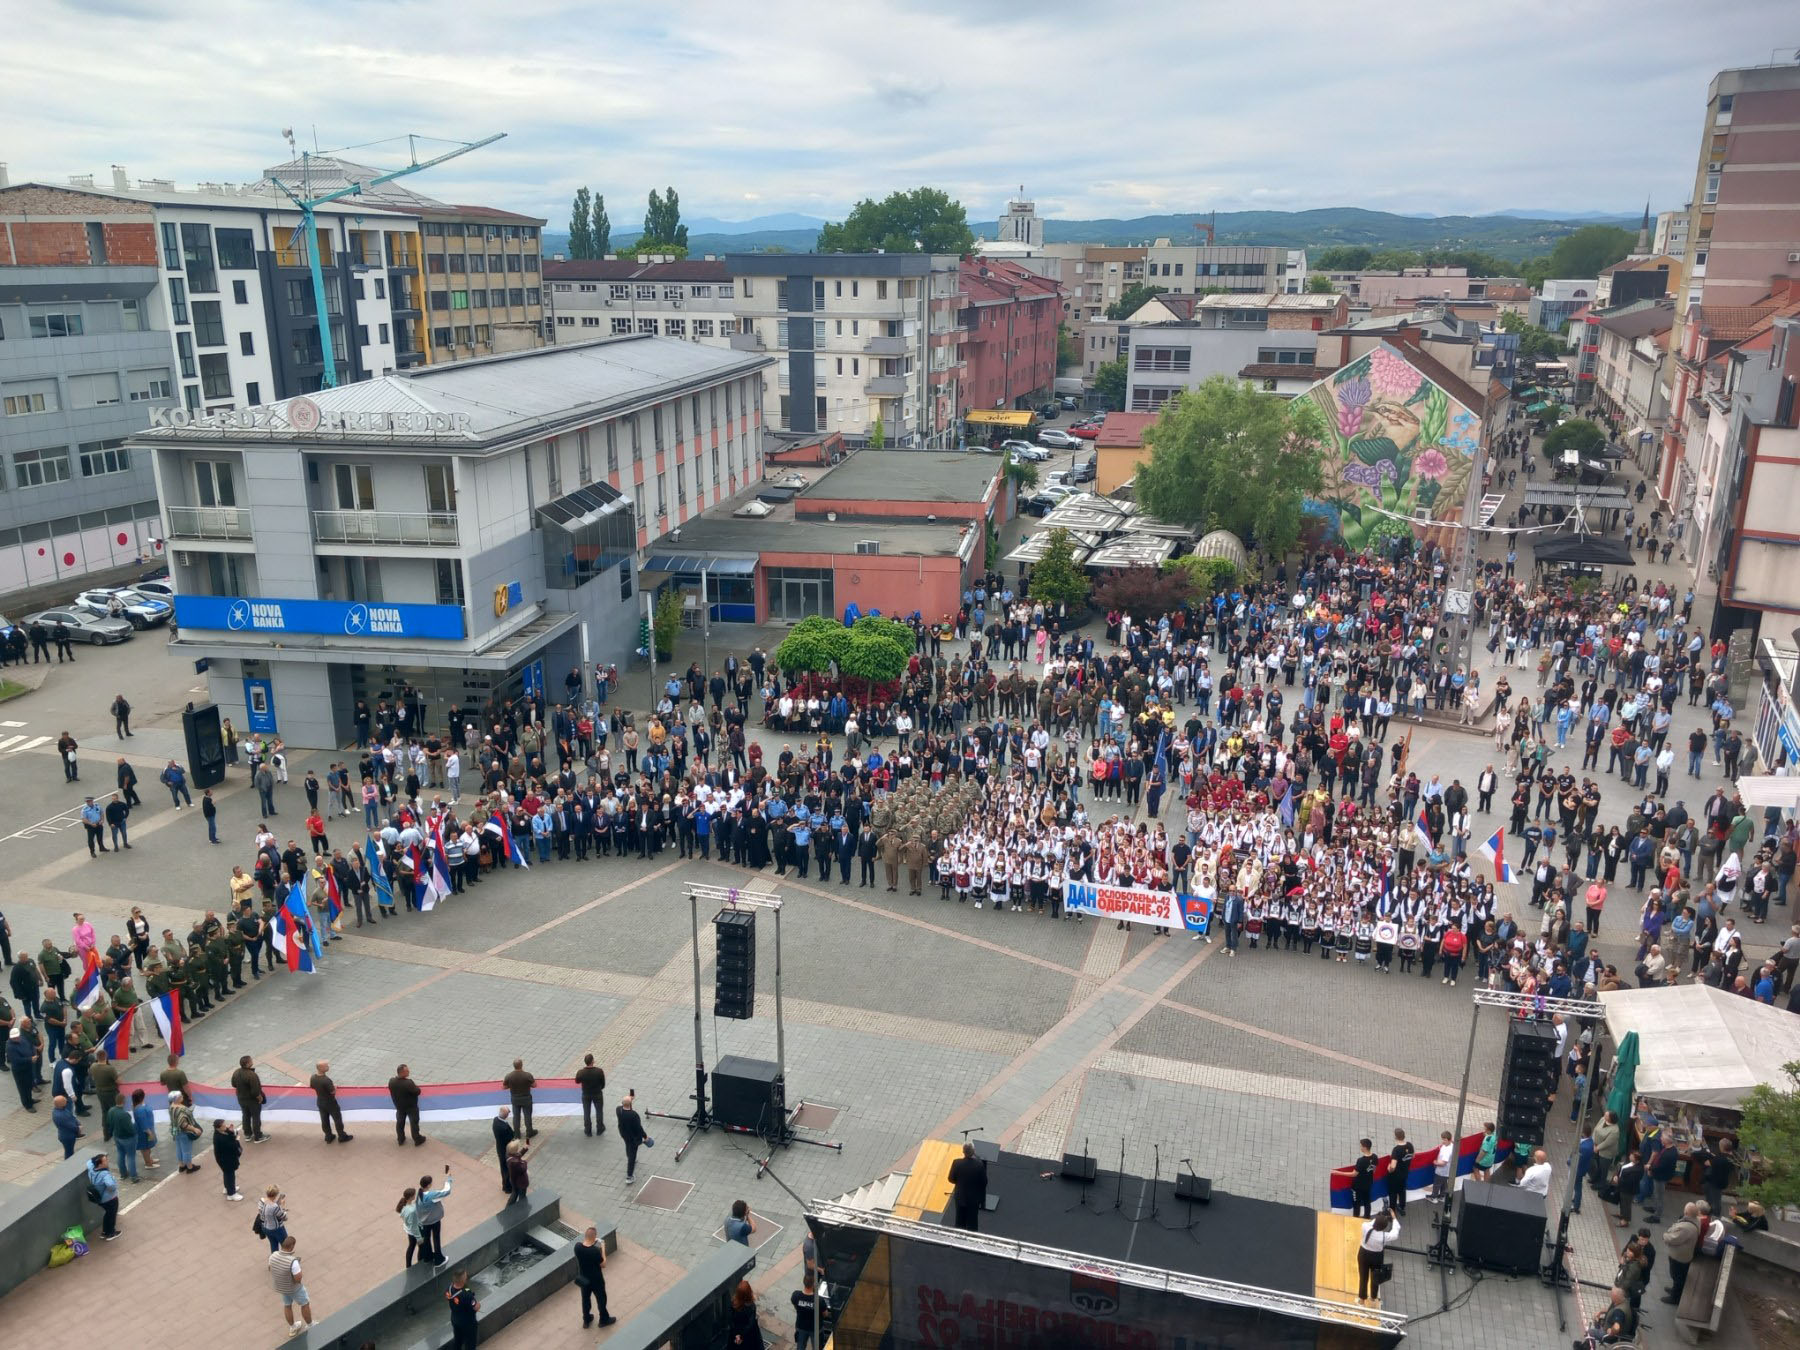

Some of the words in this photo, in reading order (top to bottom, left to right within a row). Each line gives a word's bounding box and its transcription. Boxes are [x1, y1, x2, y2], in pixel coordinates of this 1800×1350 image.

[148, 405, 277, 429] KOLEDŽ
[325, 411, 474, 432] PRIJEDOR
[251, 604, 282, 618] NOVA
[369, 608, 401, 622] NOVA
[253, 617, 285, 628] BANKA
[370, 621, 403, 633] BANKA
[1067, 884, 1097, 908] ДАН
[1097, 898, 1171, 919] ОДБРАНЕ-92
